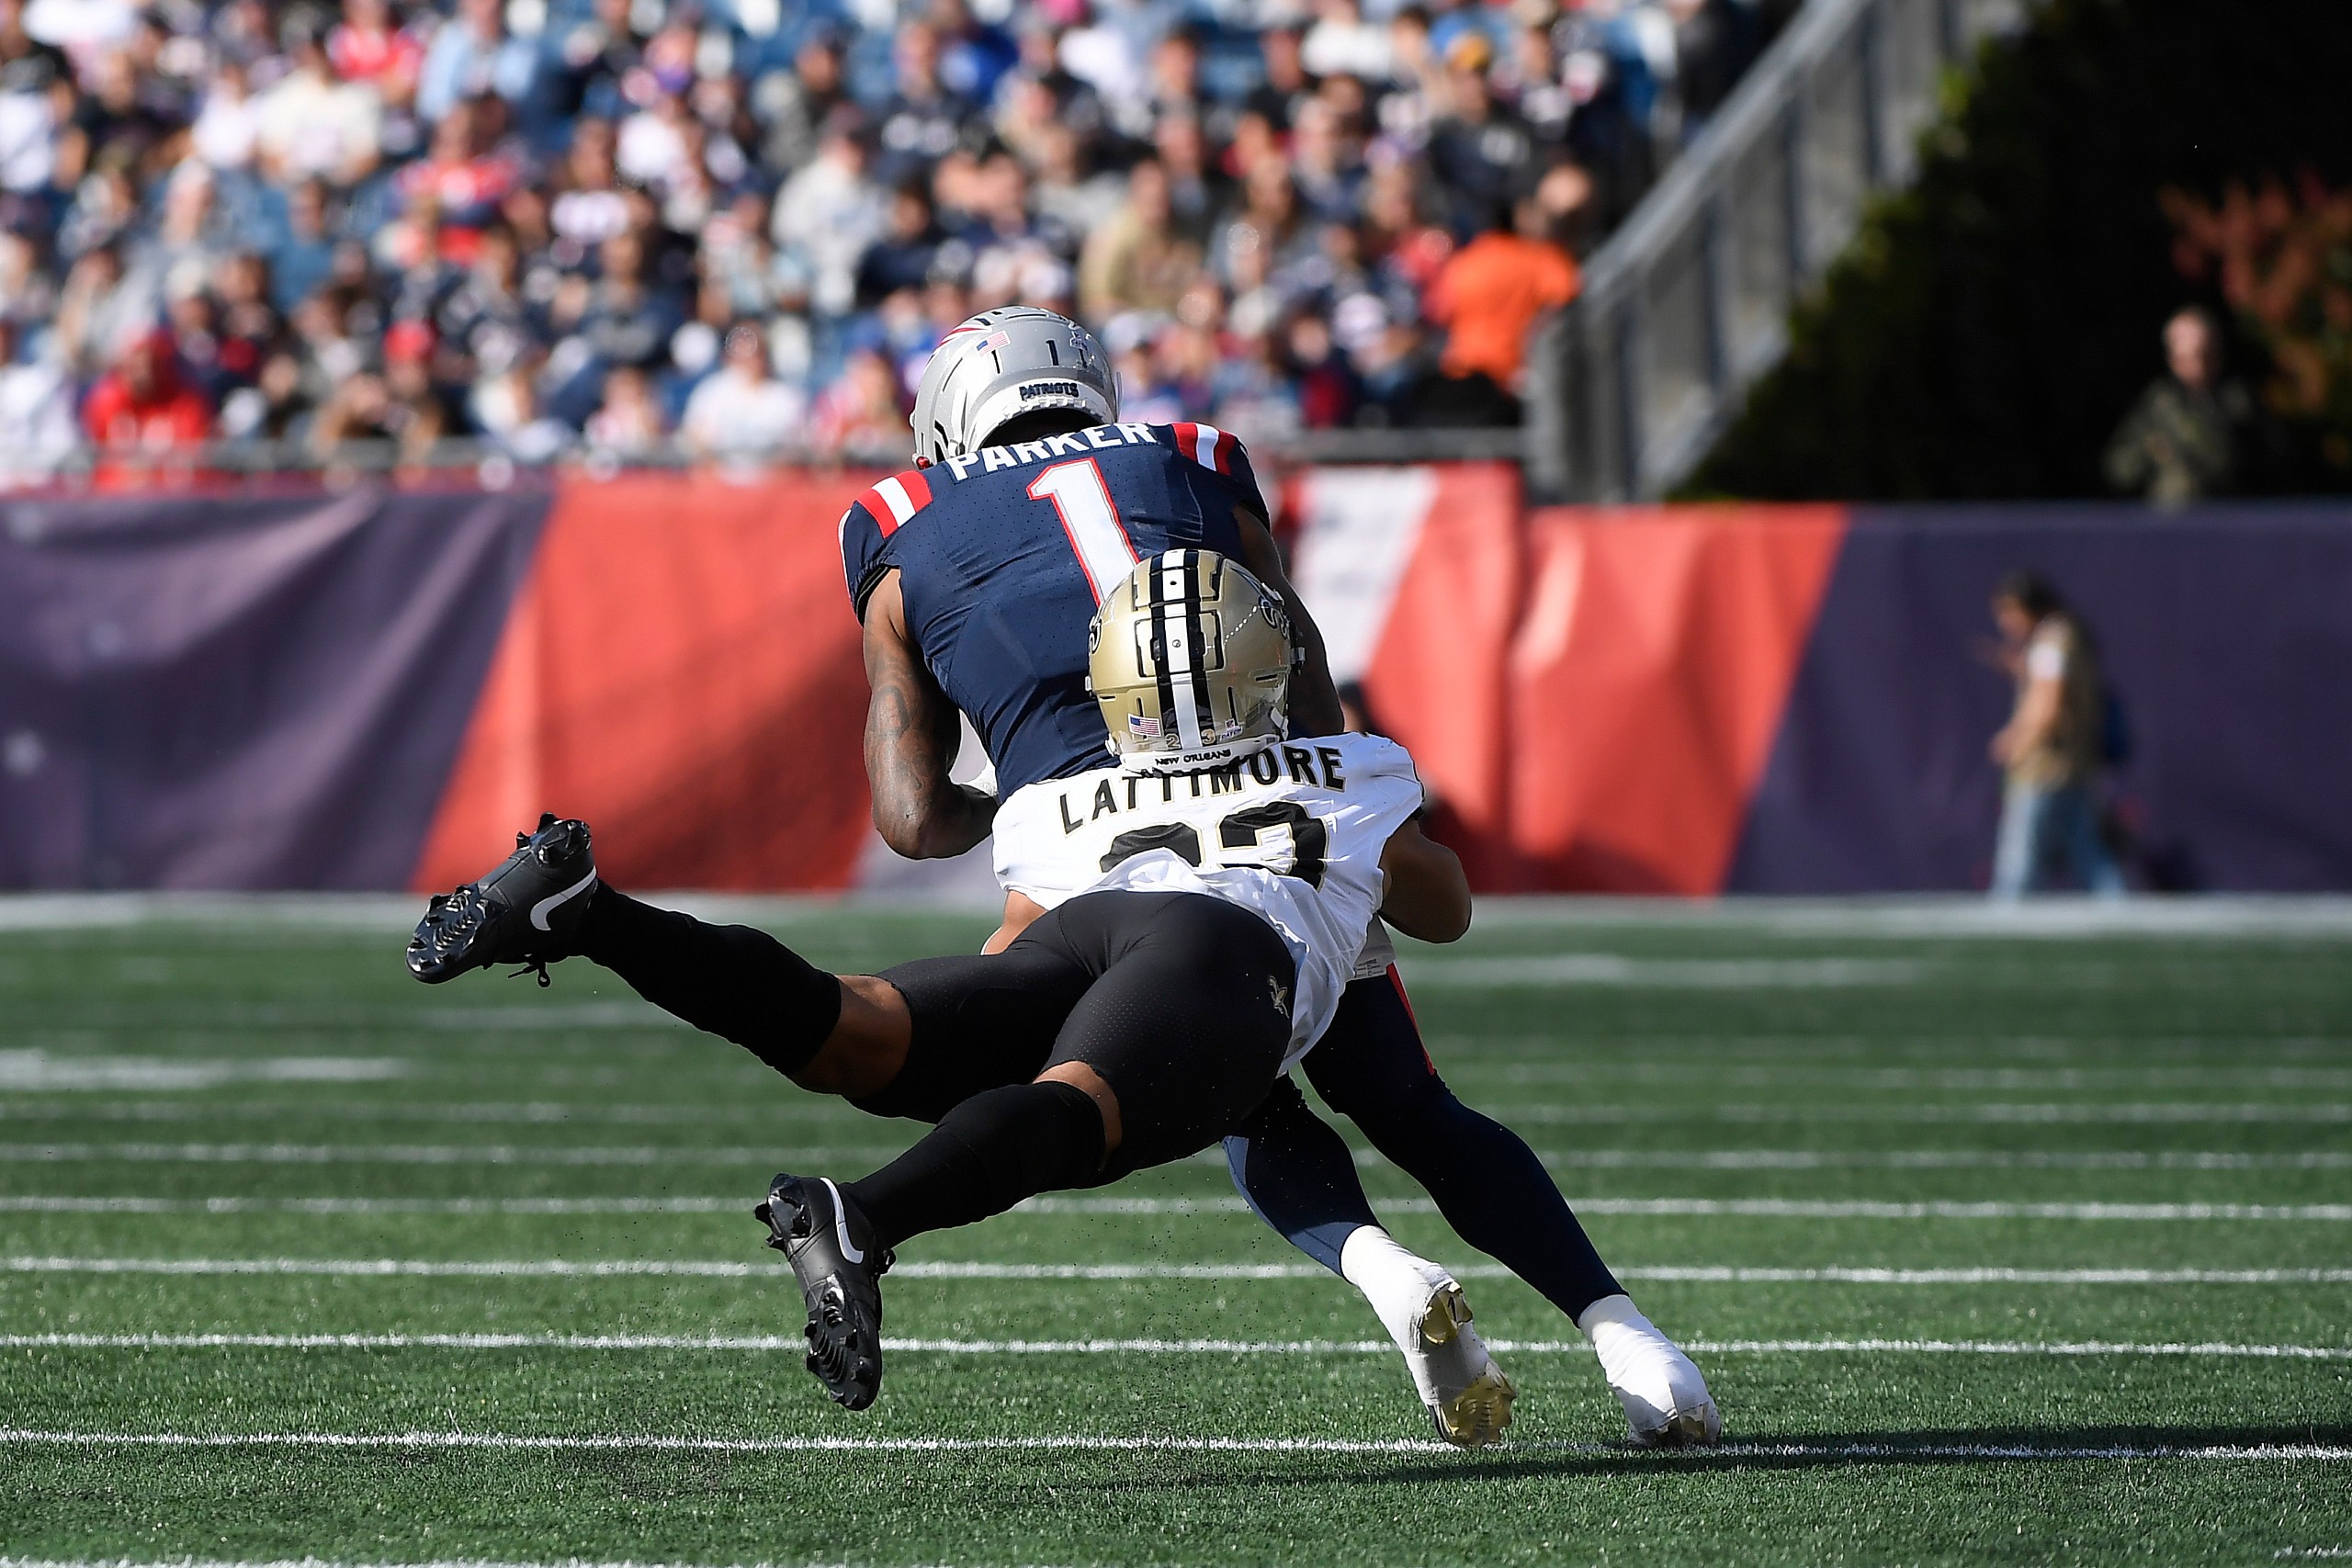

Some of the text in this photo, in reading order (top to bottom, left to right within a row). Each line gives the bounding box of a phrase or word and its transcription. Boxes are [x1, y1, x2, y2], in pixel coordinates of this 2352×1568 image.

[1019, 382, 1080, 401] PATRIOTS
[945, 422, 1158, 481] PARKER
[1025, 457, 1140, 608] 1
[1155, 749, 1232, 766] NEW ORLEANS
[1057, 742, 1347, 837] LATTIMORE
